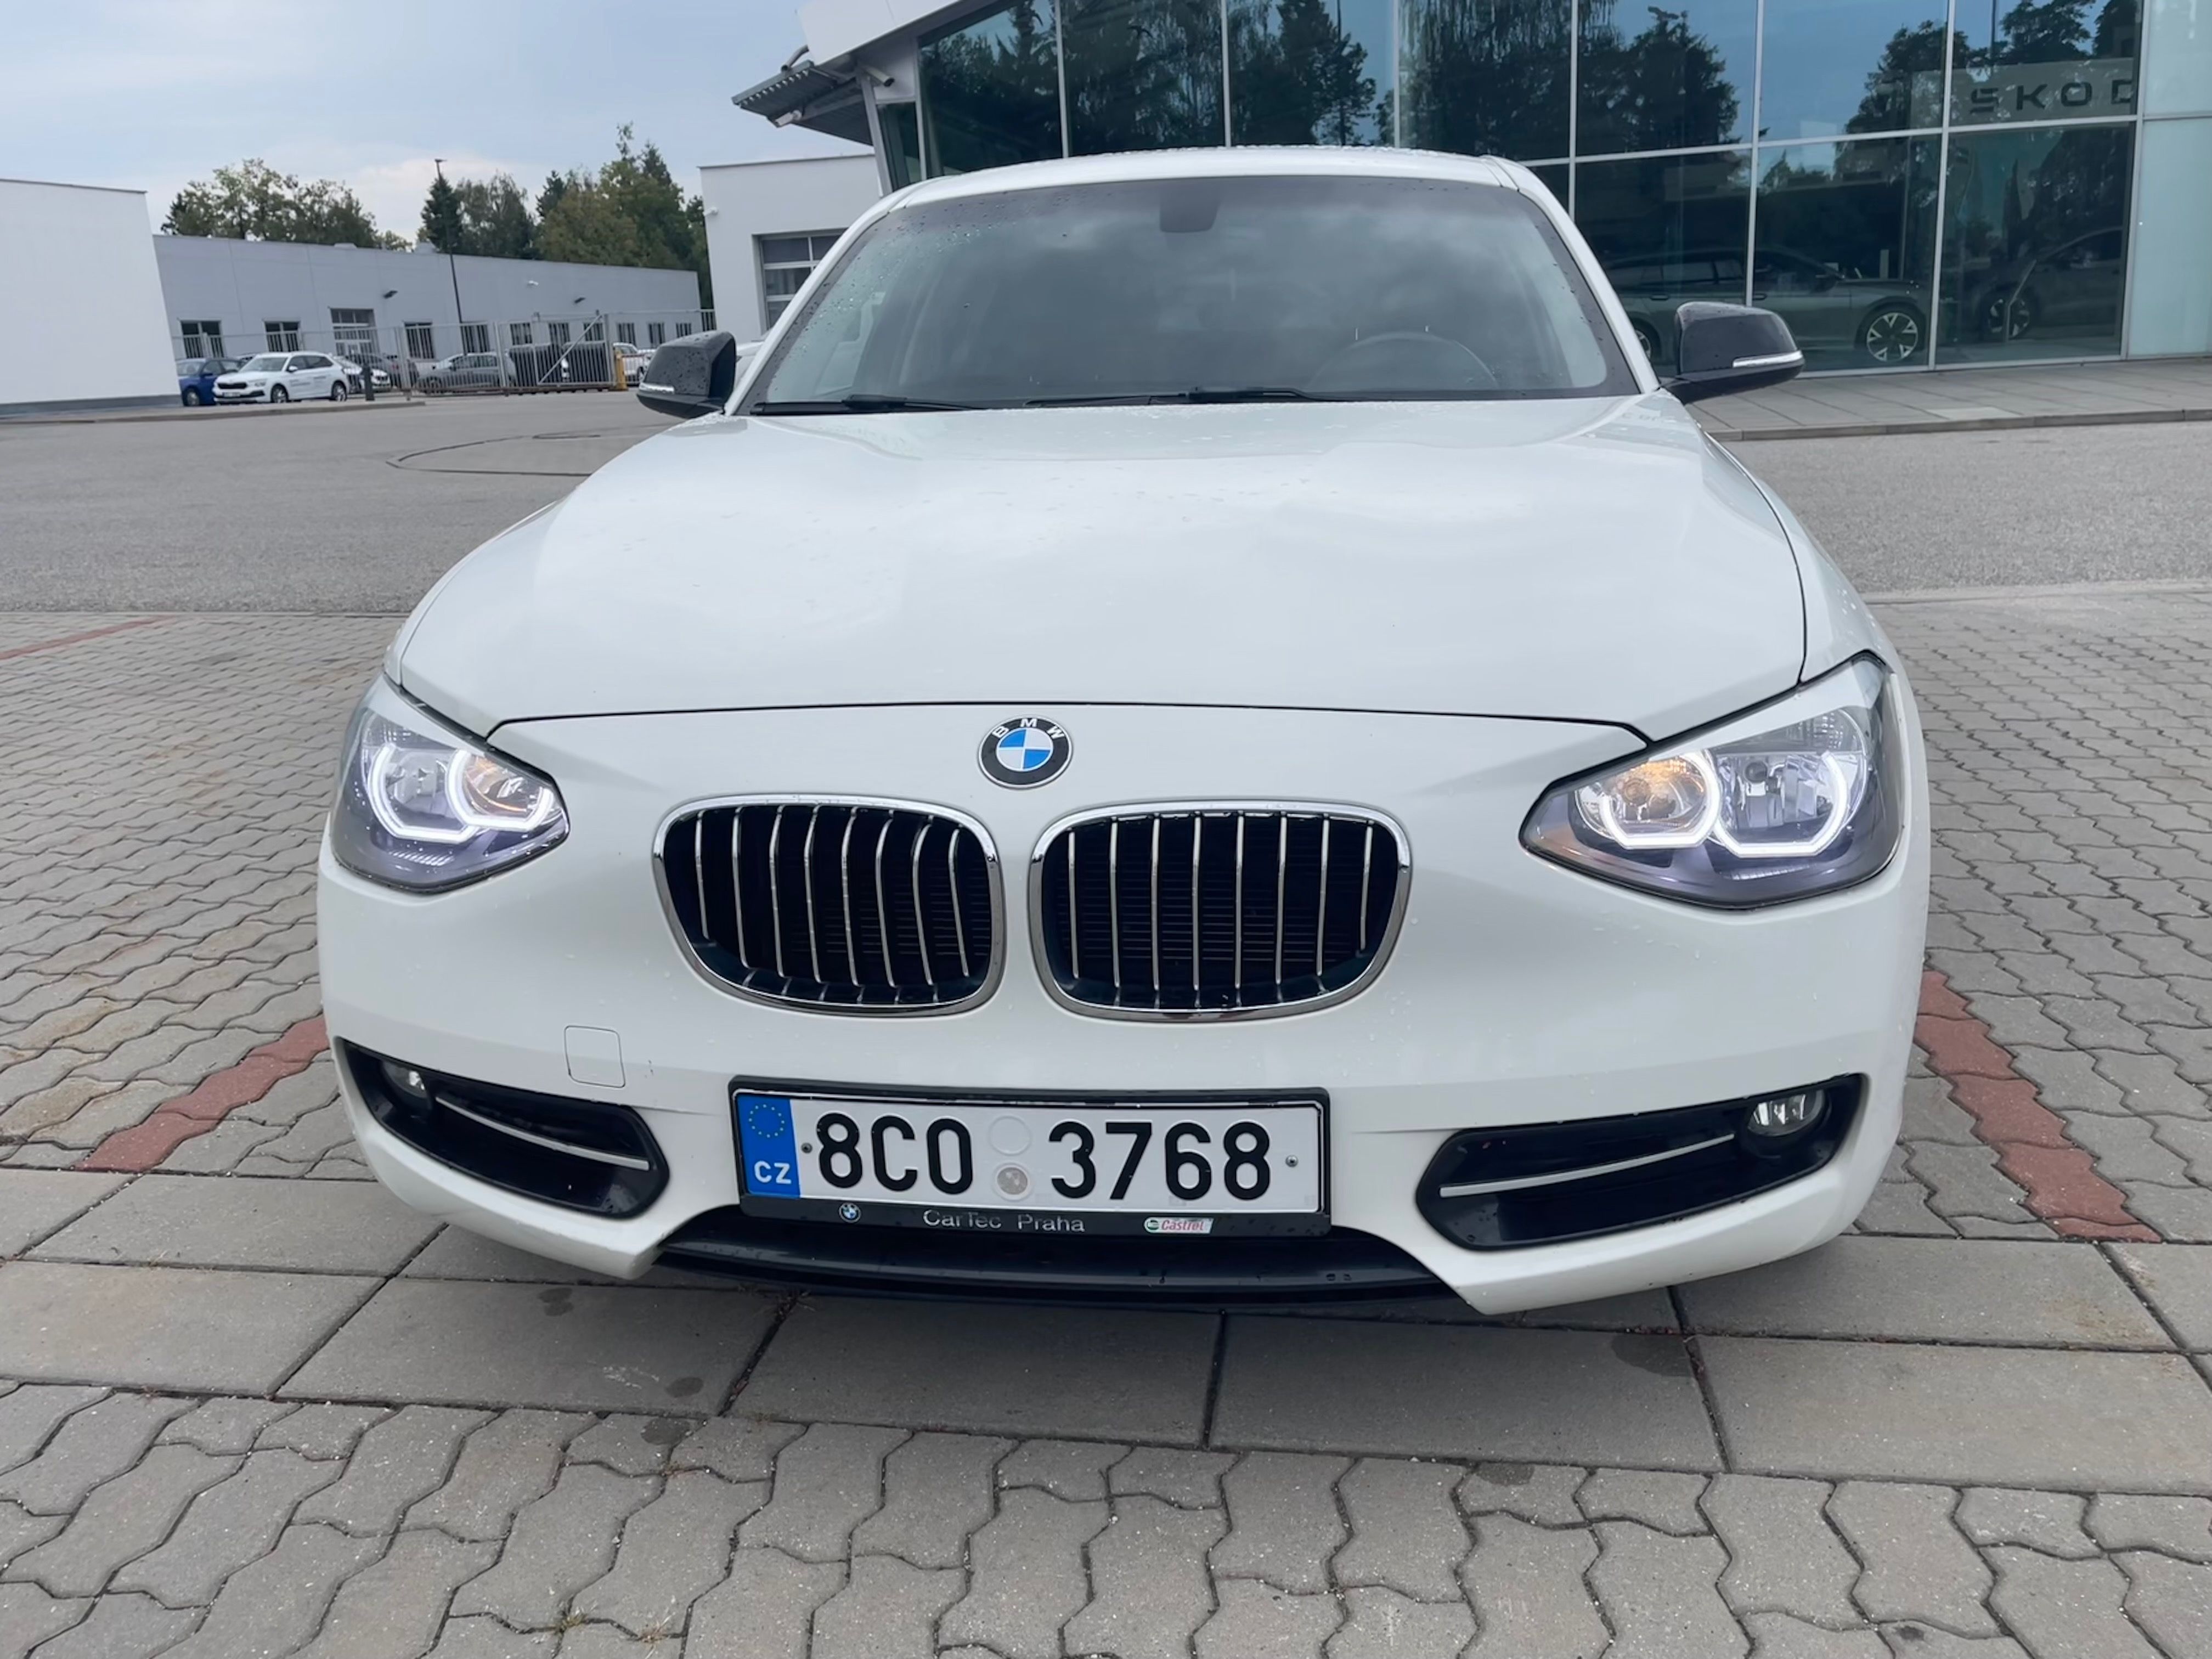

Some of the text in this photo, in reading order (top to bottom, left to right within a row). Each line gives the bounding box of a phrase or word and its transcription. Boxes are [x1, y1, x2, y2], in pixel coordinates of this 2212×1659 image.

[991, 718, 1065, 740] BMW
[816, 1112, 1271, 1201] 8C0 3768
[754, 1160, 792, 1184] CZ
[1017, 1214, 1085, 1232] Praha
